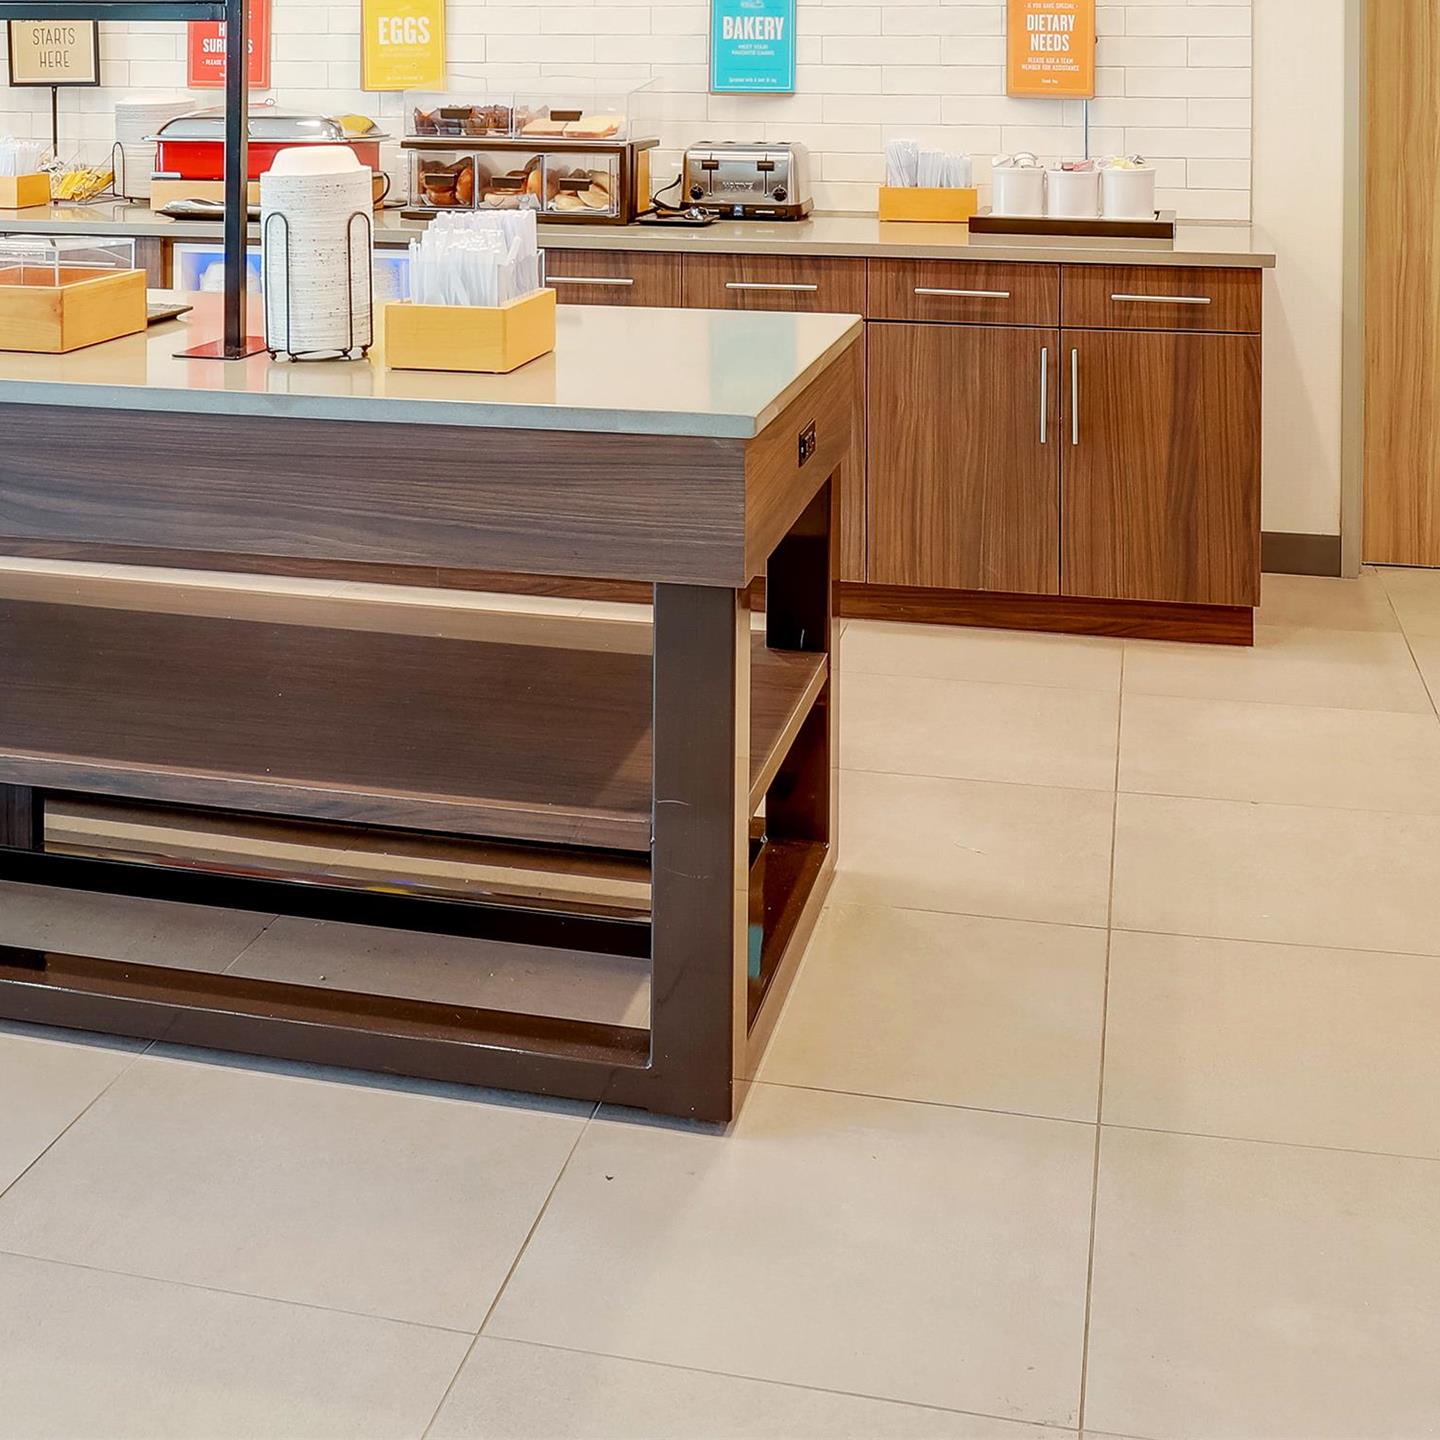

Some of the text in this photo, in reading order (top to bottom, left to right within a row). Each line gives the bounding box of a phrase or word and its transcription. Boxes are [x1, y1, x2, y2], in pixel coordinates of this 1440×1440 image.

[378, 16, 430, 45] EGGS
[723, 16, 784, 40] BAKERY
[1026, 14, 1075, 32] DIETARY
[32, 28, 76, 46] STARTS
[1030, 33, 1070, 52] NEEDS
[39, 50, 71, 68] HERE
